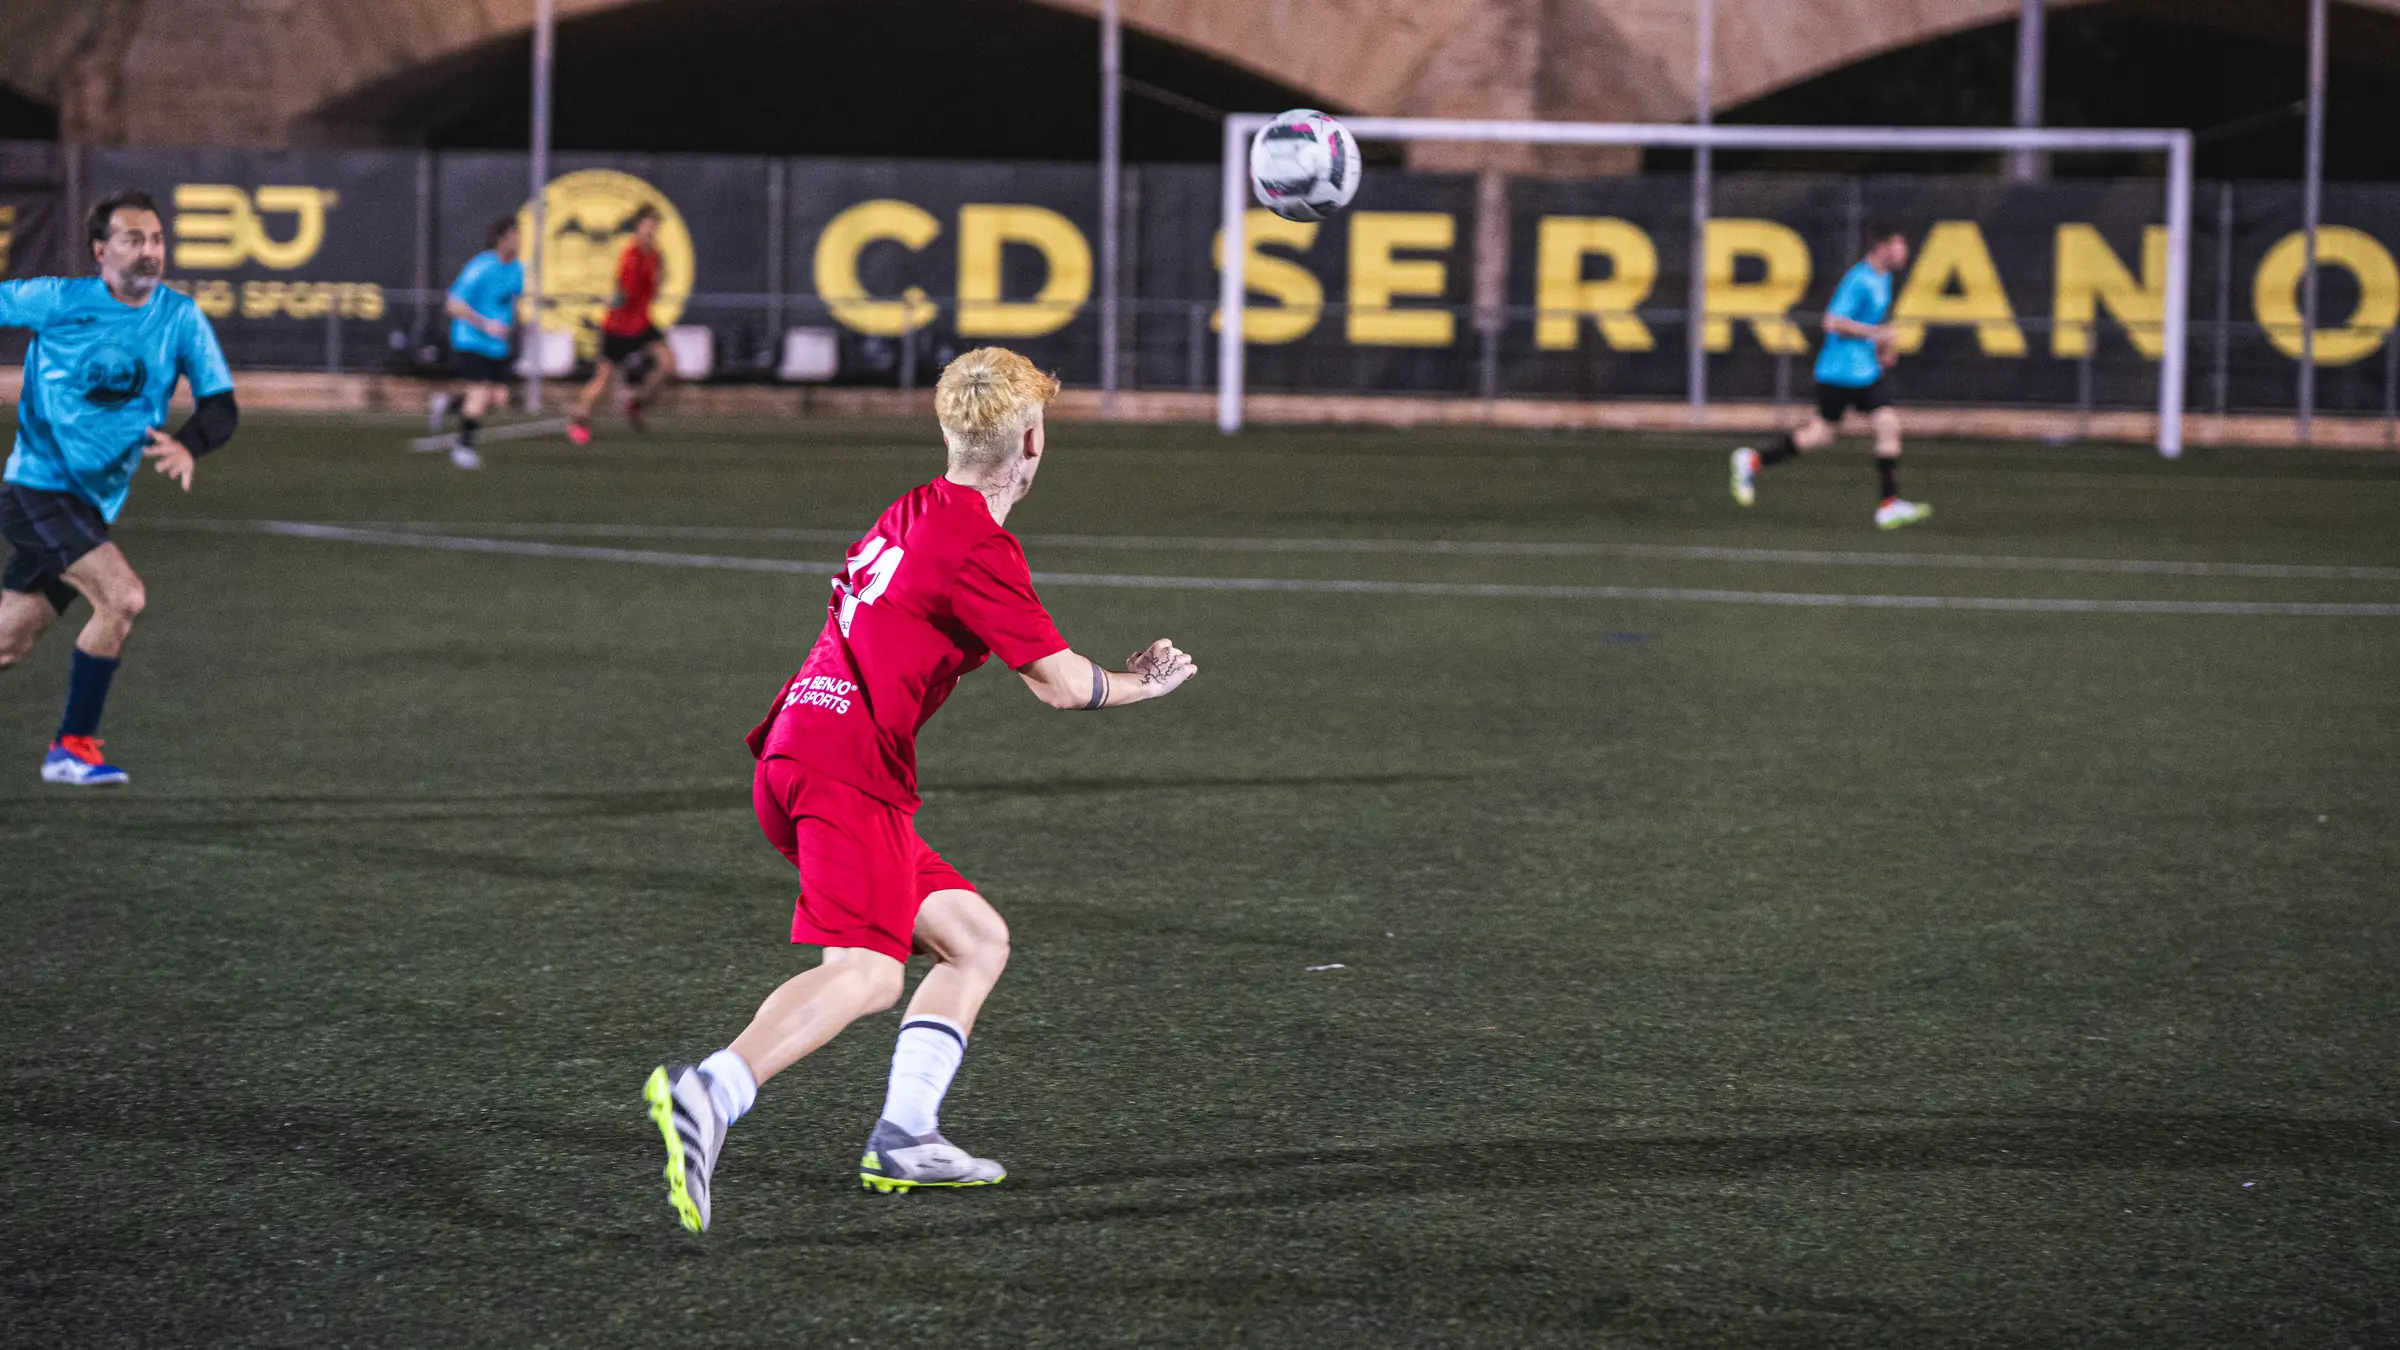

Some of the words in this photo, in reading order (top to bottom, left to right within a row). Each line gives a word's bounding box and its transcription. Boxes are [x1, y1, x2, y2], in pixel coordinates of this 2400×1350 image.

[813, 199, 1092, 338] CD
[1211, 207, 2400, 366] SERRANO
[800, 690, 851, 714] SPORTS
